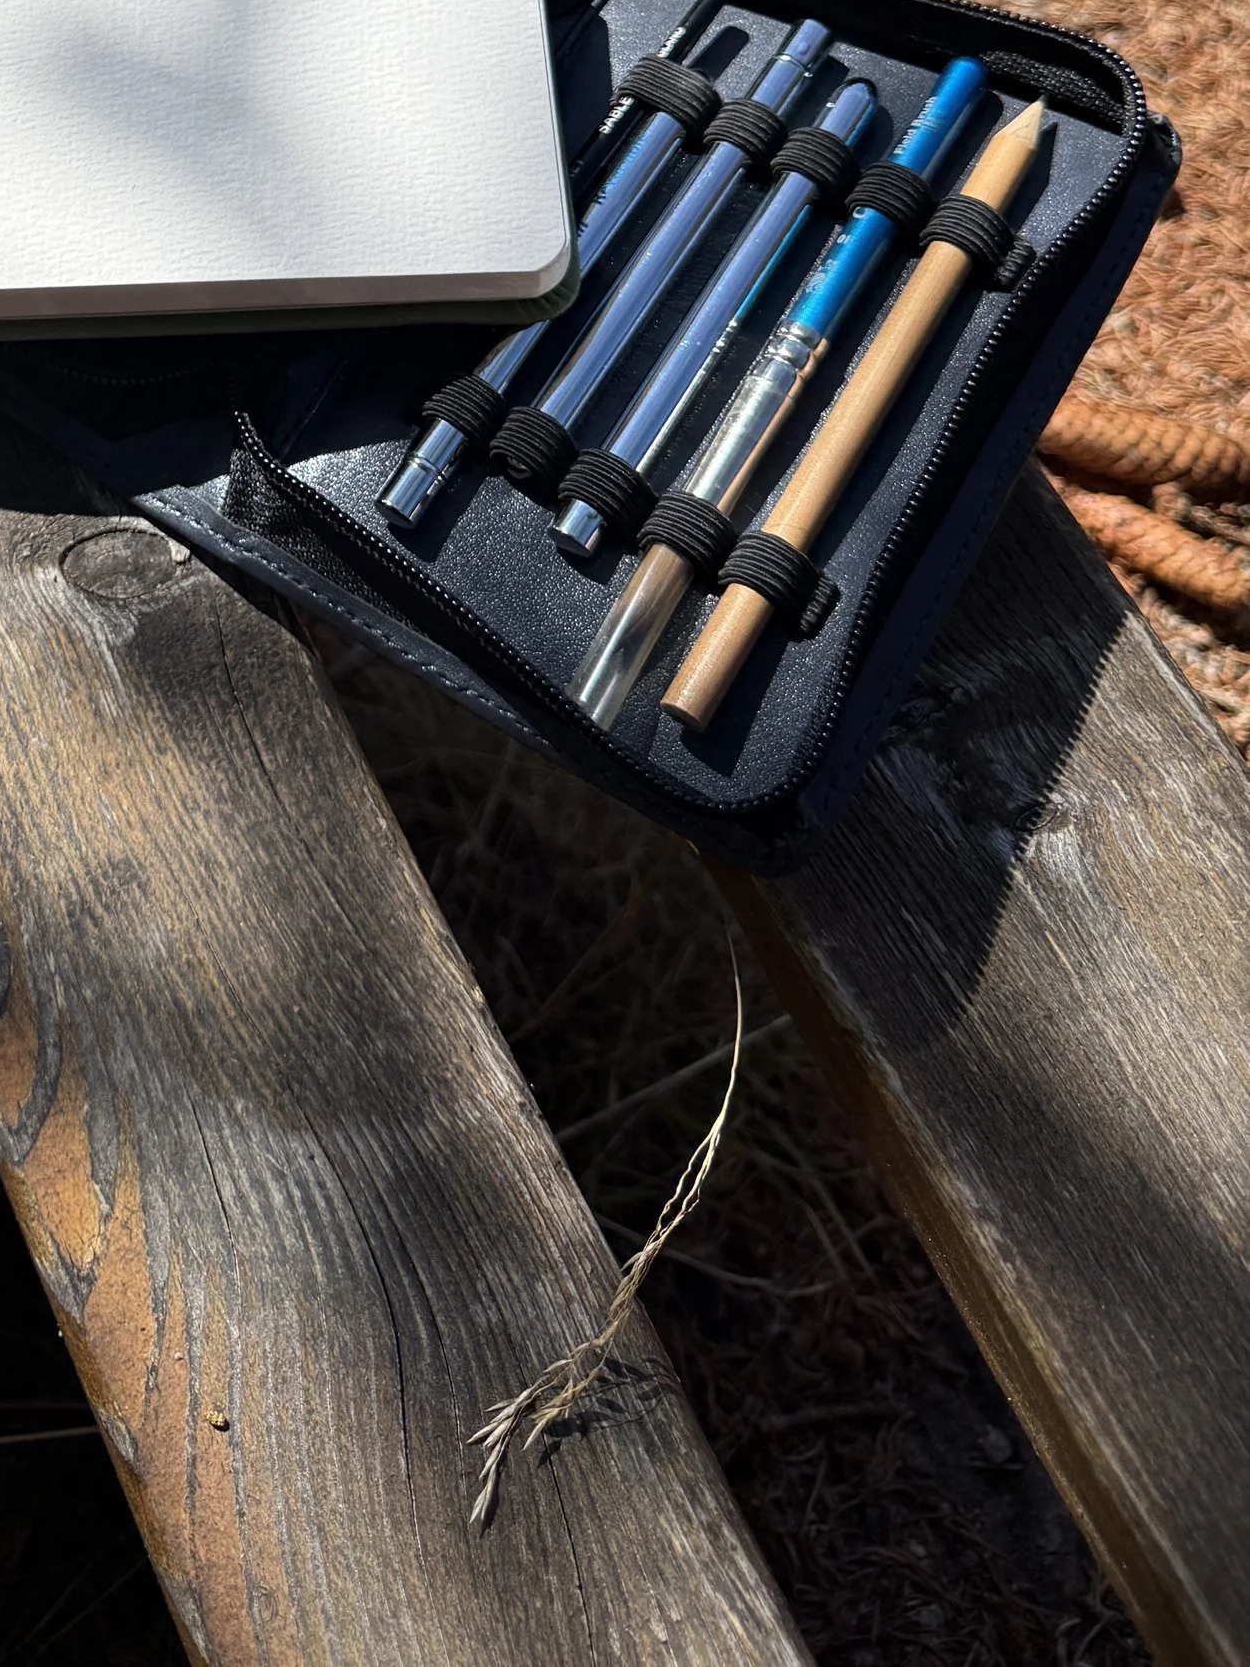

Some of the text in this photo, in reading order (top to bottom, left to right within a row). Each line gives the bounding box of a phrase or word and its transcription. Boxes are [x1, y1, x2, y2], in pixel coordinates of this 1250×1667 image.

[598, 95, 636, 134] SABLE
[893, 96, 939, 154] Field Brush
